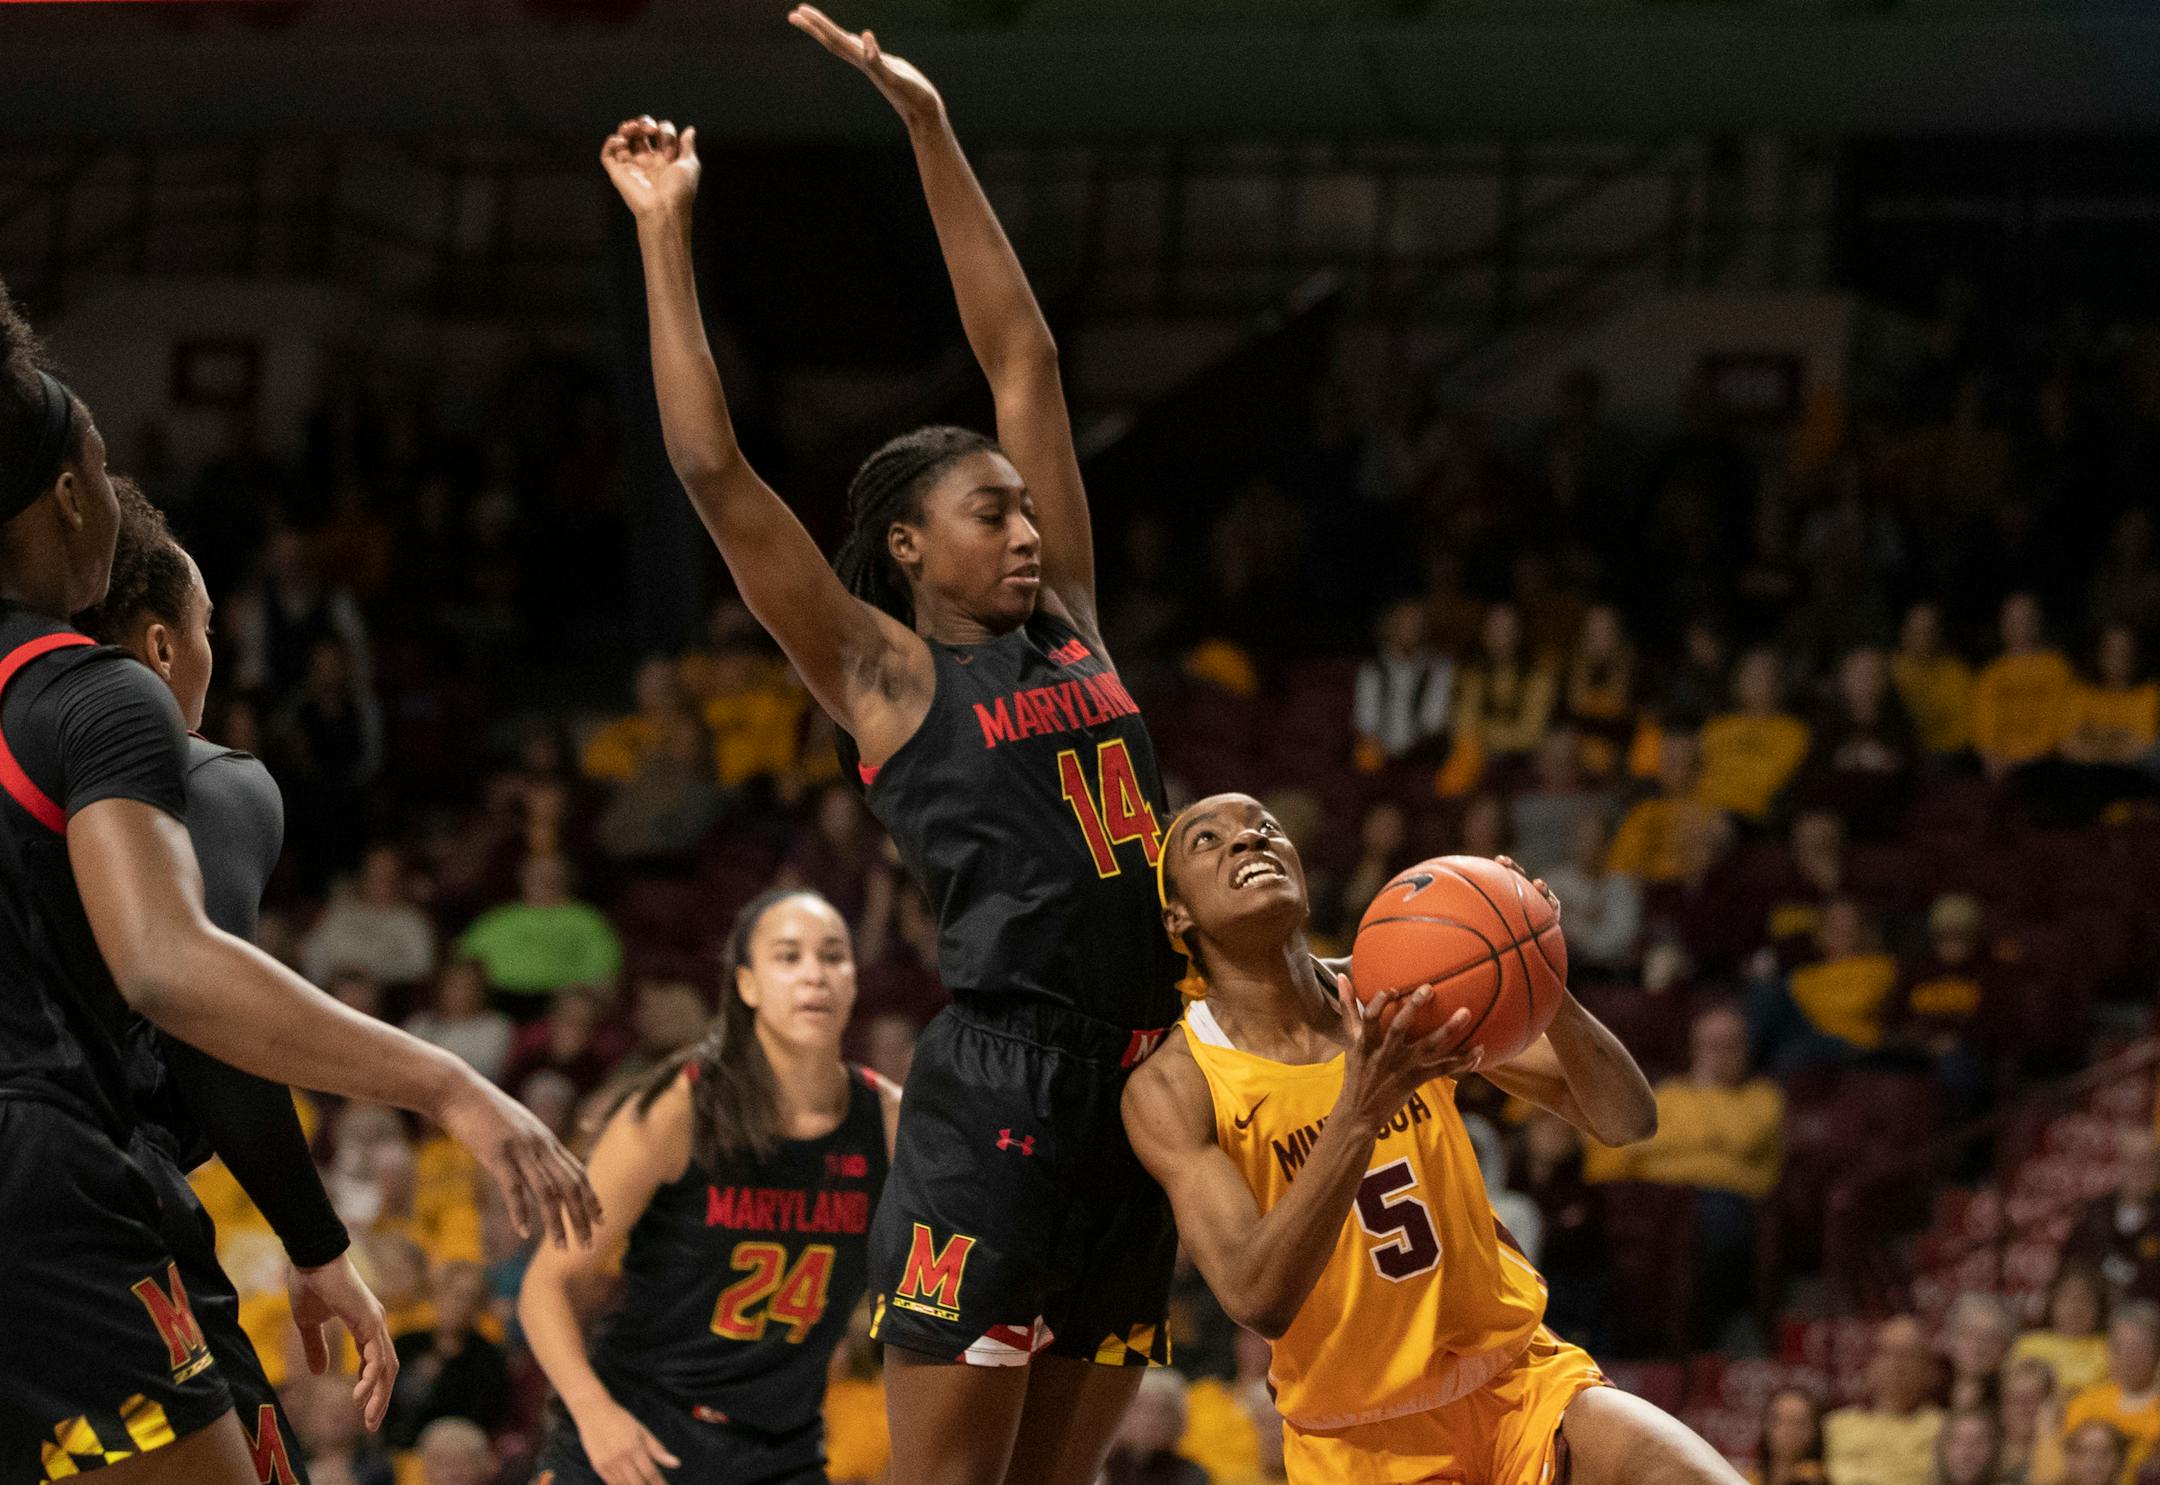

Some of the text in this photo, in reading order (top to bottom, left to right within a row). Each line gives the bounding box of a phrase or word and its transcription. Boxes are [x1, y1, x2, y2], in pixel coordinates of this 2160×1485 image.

[1057, 738, 1161, 879] 14
[706, 1185, 868, 1234] MARYLAND
[1354, 1156, 1443, 1283] 5
[710, 1241, 837, 1343] 24
[896, 1223, 976, 1310] M
